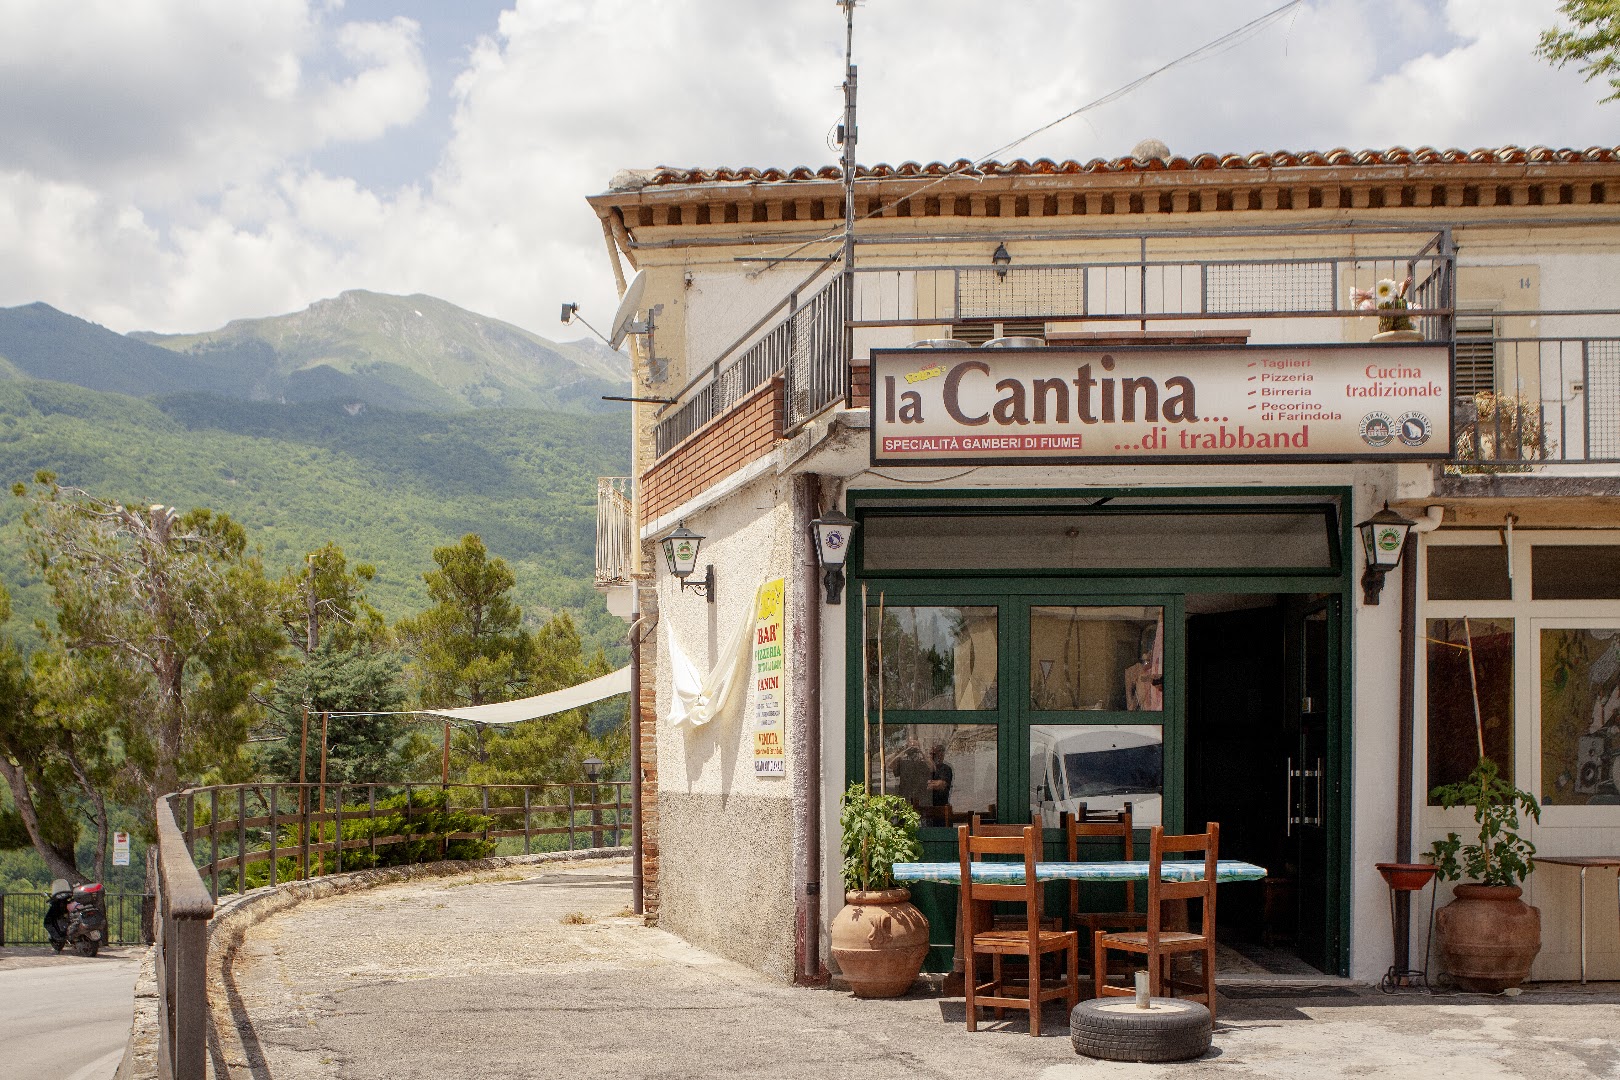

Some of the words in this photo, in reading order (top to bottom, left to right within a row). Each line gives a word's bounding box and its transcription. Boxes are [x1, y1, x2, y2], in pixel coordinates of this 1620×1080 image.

[1519, 277, 1531, 289] 14
[1261, 358, 1312, 370] Taglieri
[1365, 363, 1422, 379] Cucina
[1261, 373, 1314, 382] Pizzeria
[1261, 387, 1312, 396] Birreria
[1346, 381, 1442, 397] tradizionale
[885, 375, 924, 424] la
[1261, 401, 1322, 411] Pecorino
[1261, 412, 1274, 421] di
[1278, 411, 1342, 421] Farindola
[1179, 425, 1309, 449] trabband
[885, 437, 959, 451] SPECIALITÀ
[962, 437, 1021, 449] GAMBERI
[1025, 437, 1037, 448] DI
[1041, 437, 1080, 448] FIUME
